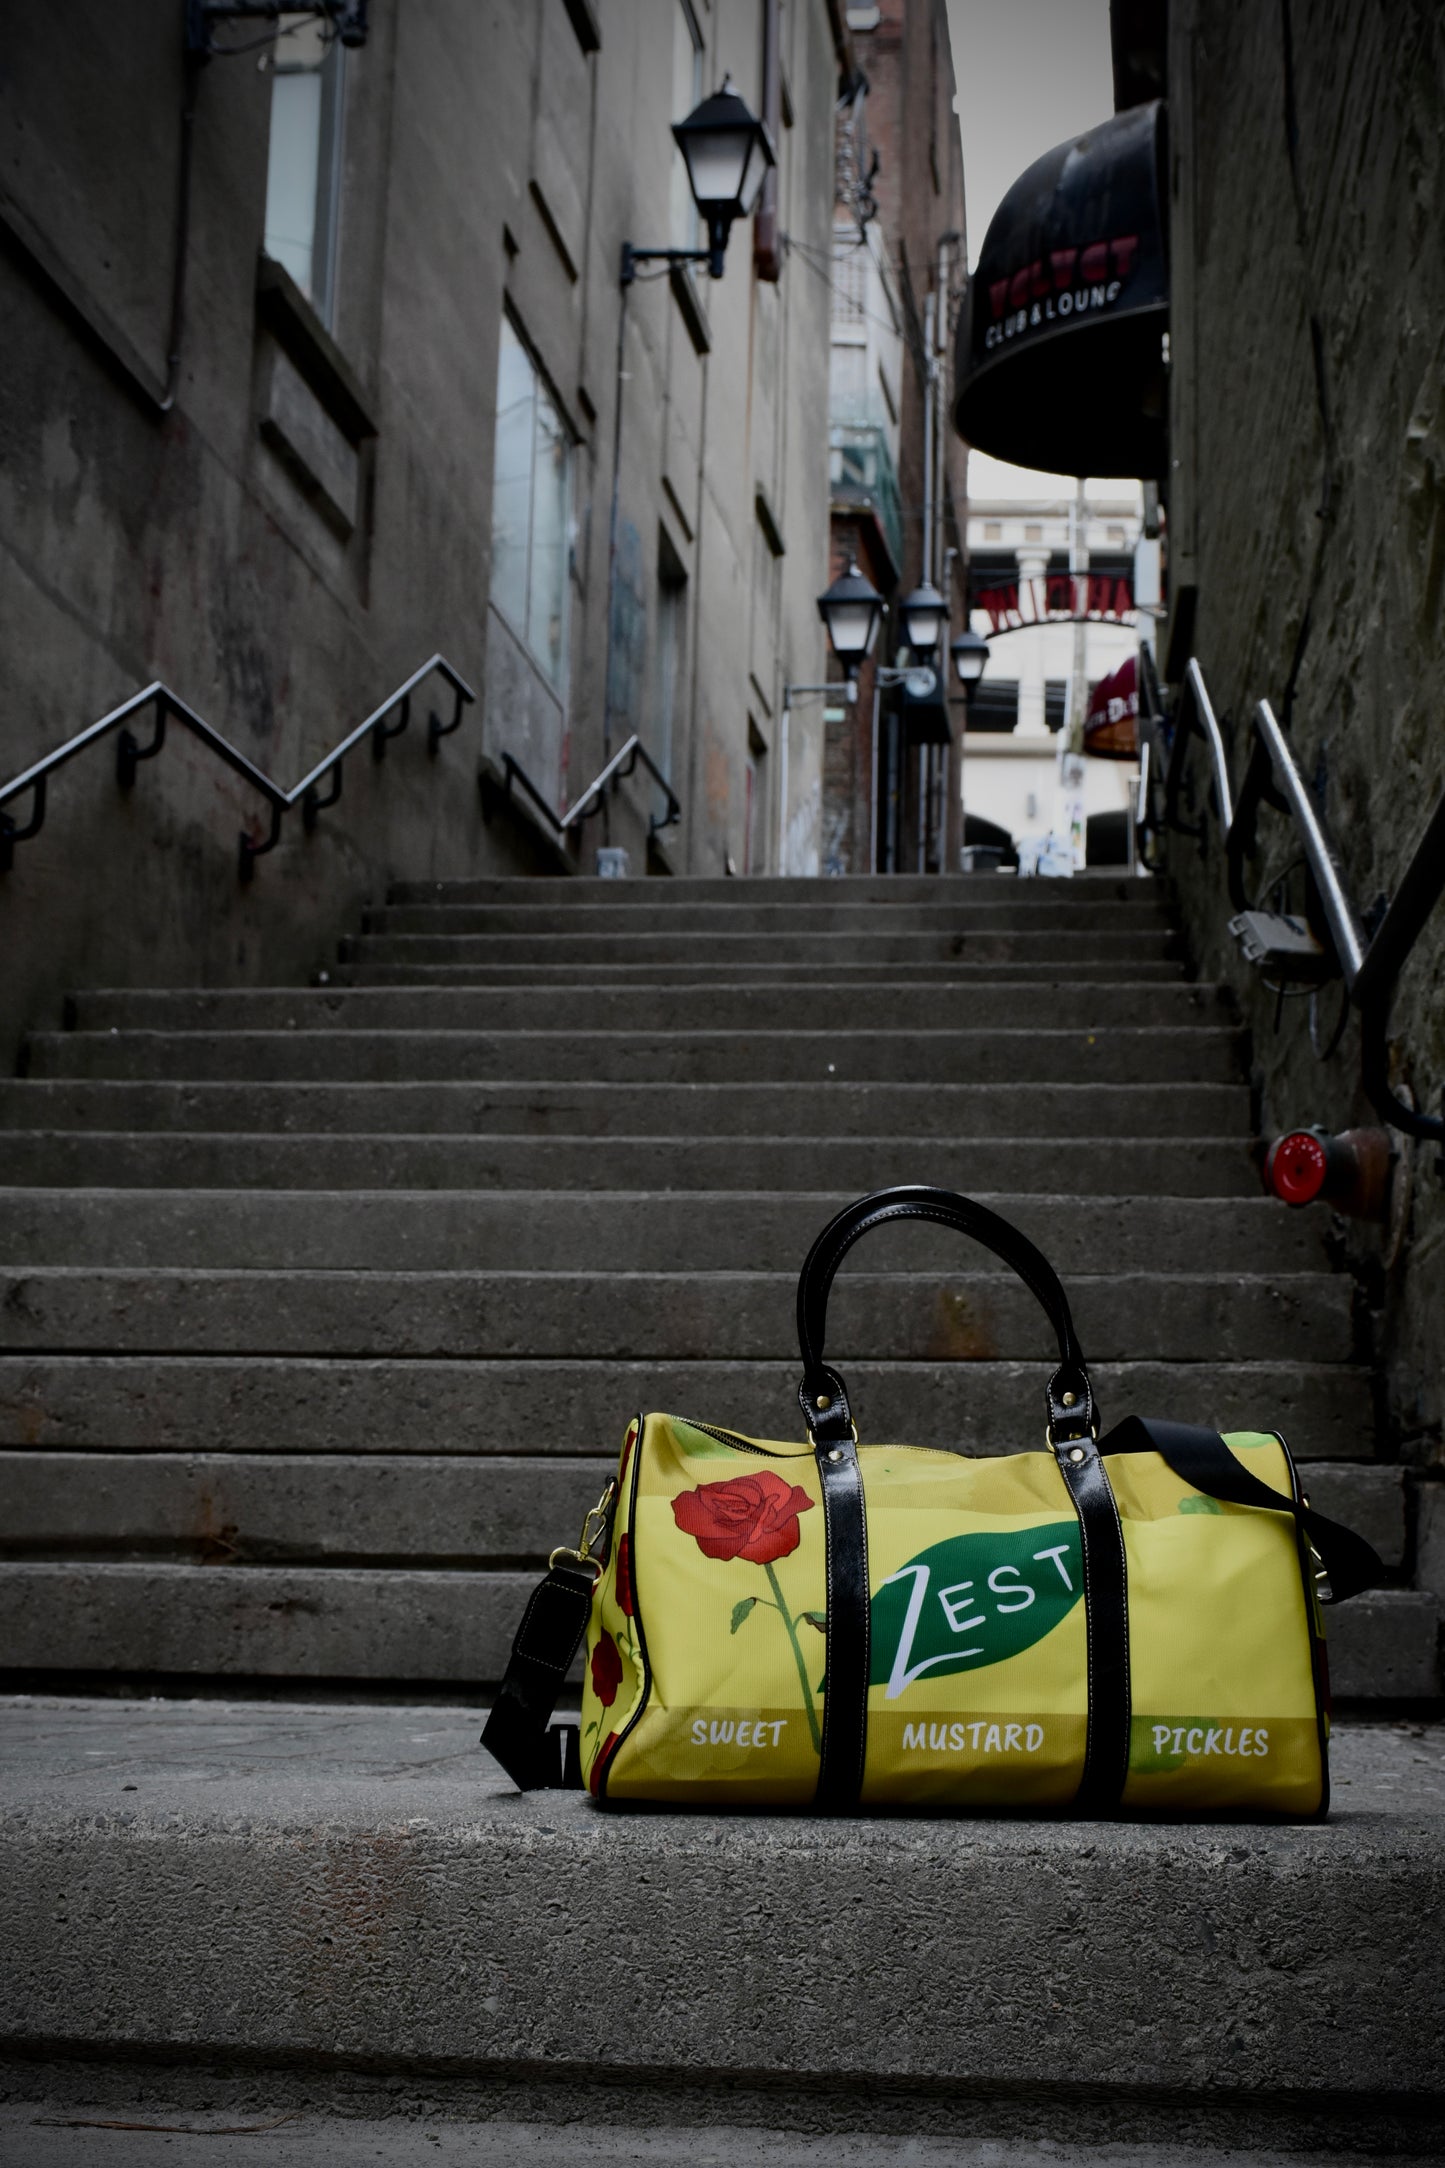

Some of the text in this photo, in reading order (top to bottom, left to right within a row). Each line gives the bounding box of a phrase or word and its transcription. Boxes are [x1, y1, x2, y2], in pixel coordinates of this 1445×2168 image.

[985, 308, 1028, 350] CLUB
[1030, 302, 1042, 326] &
[880, 1545, 1074, 1700] ZEST
[690, 1719, 1269, 1757] SWEET MUSTARD PICKLES
